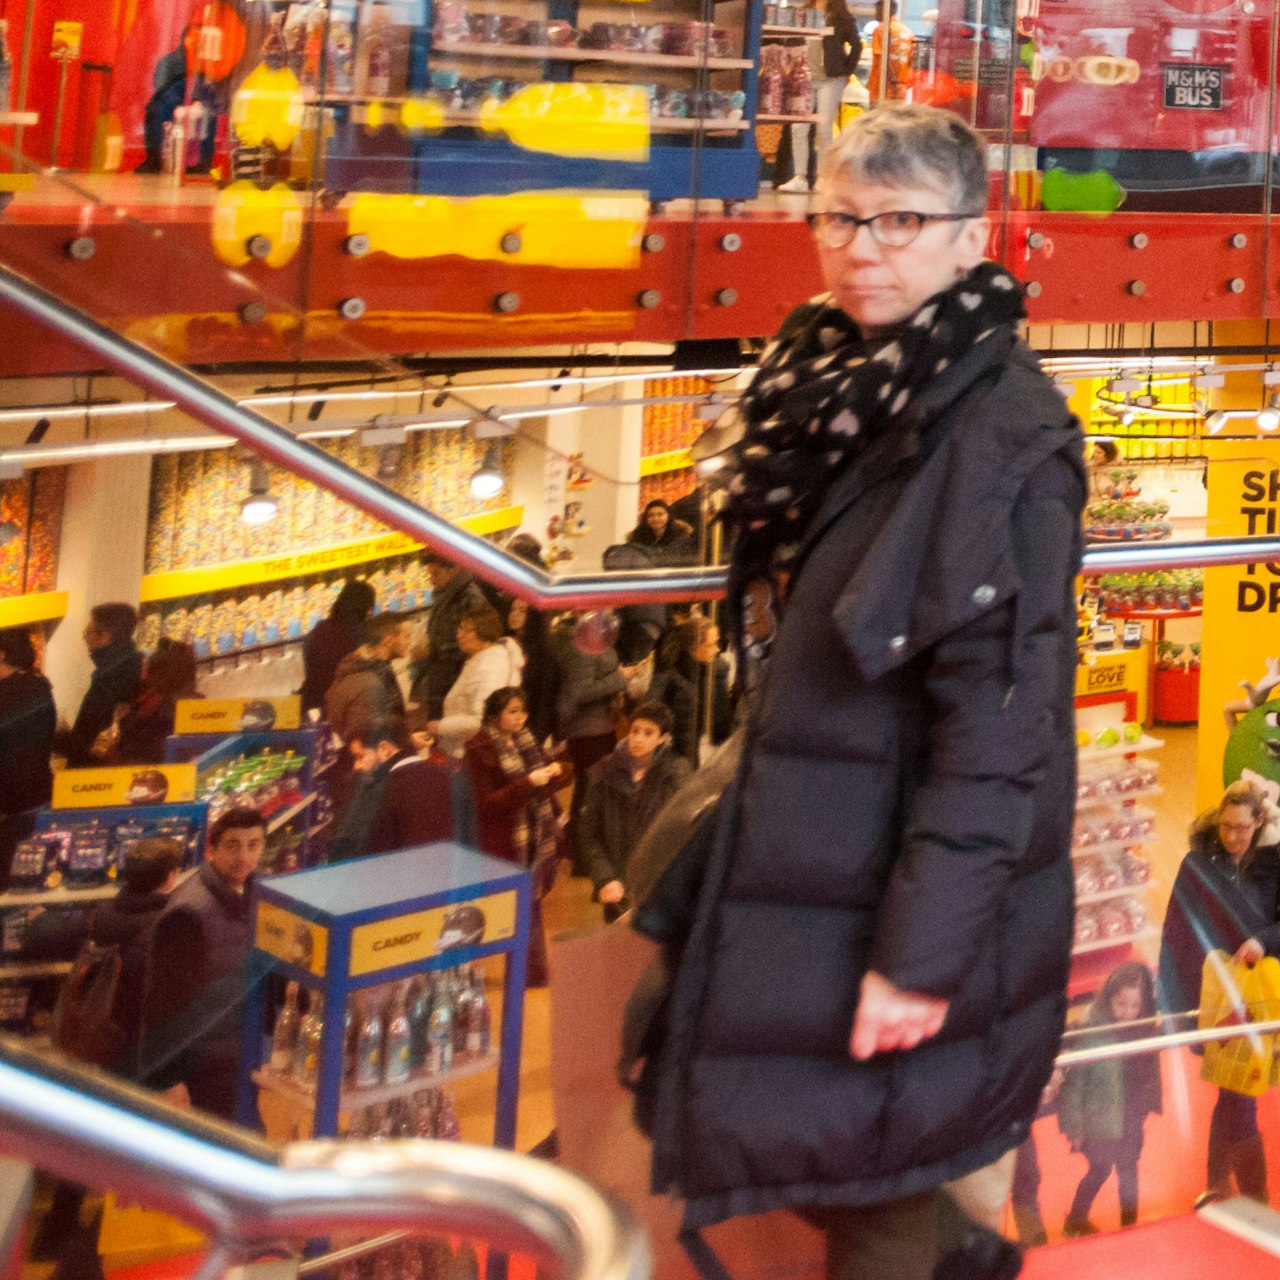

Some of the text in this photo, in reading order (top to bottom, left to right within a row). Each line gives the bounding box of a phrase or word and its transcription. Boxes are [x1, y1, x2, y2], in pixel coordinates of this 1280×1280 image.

[1167, 69, 1220, 88] M&M'S
[1174, 88, 1213, 106] BUS
[263, 555, 294, 573] THE
[295, 543, 371, 570] SWEETEST
[1088, 671, 1125, 686] LOVE
[71, 782, 115, 794] CANDY
[371, 931, 422, 952] CANDY
